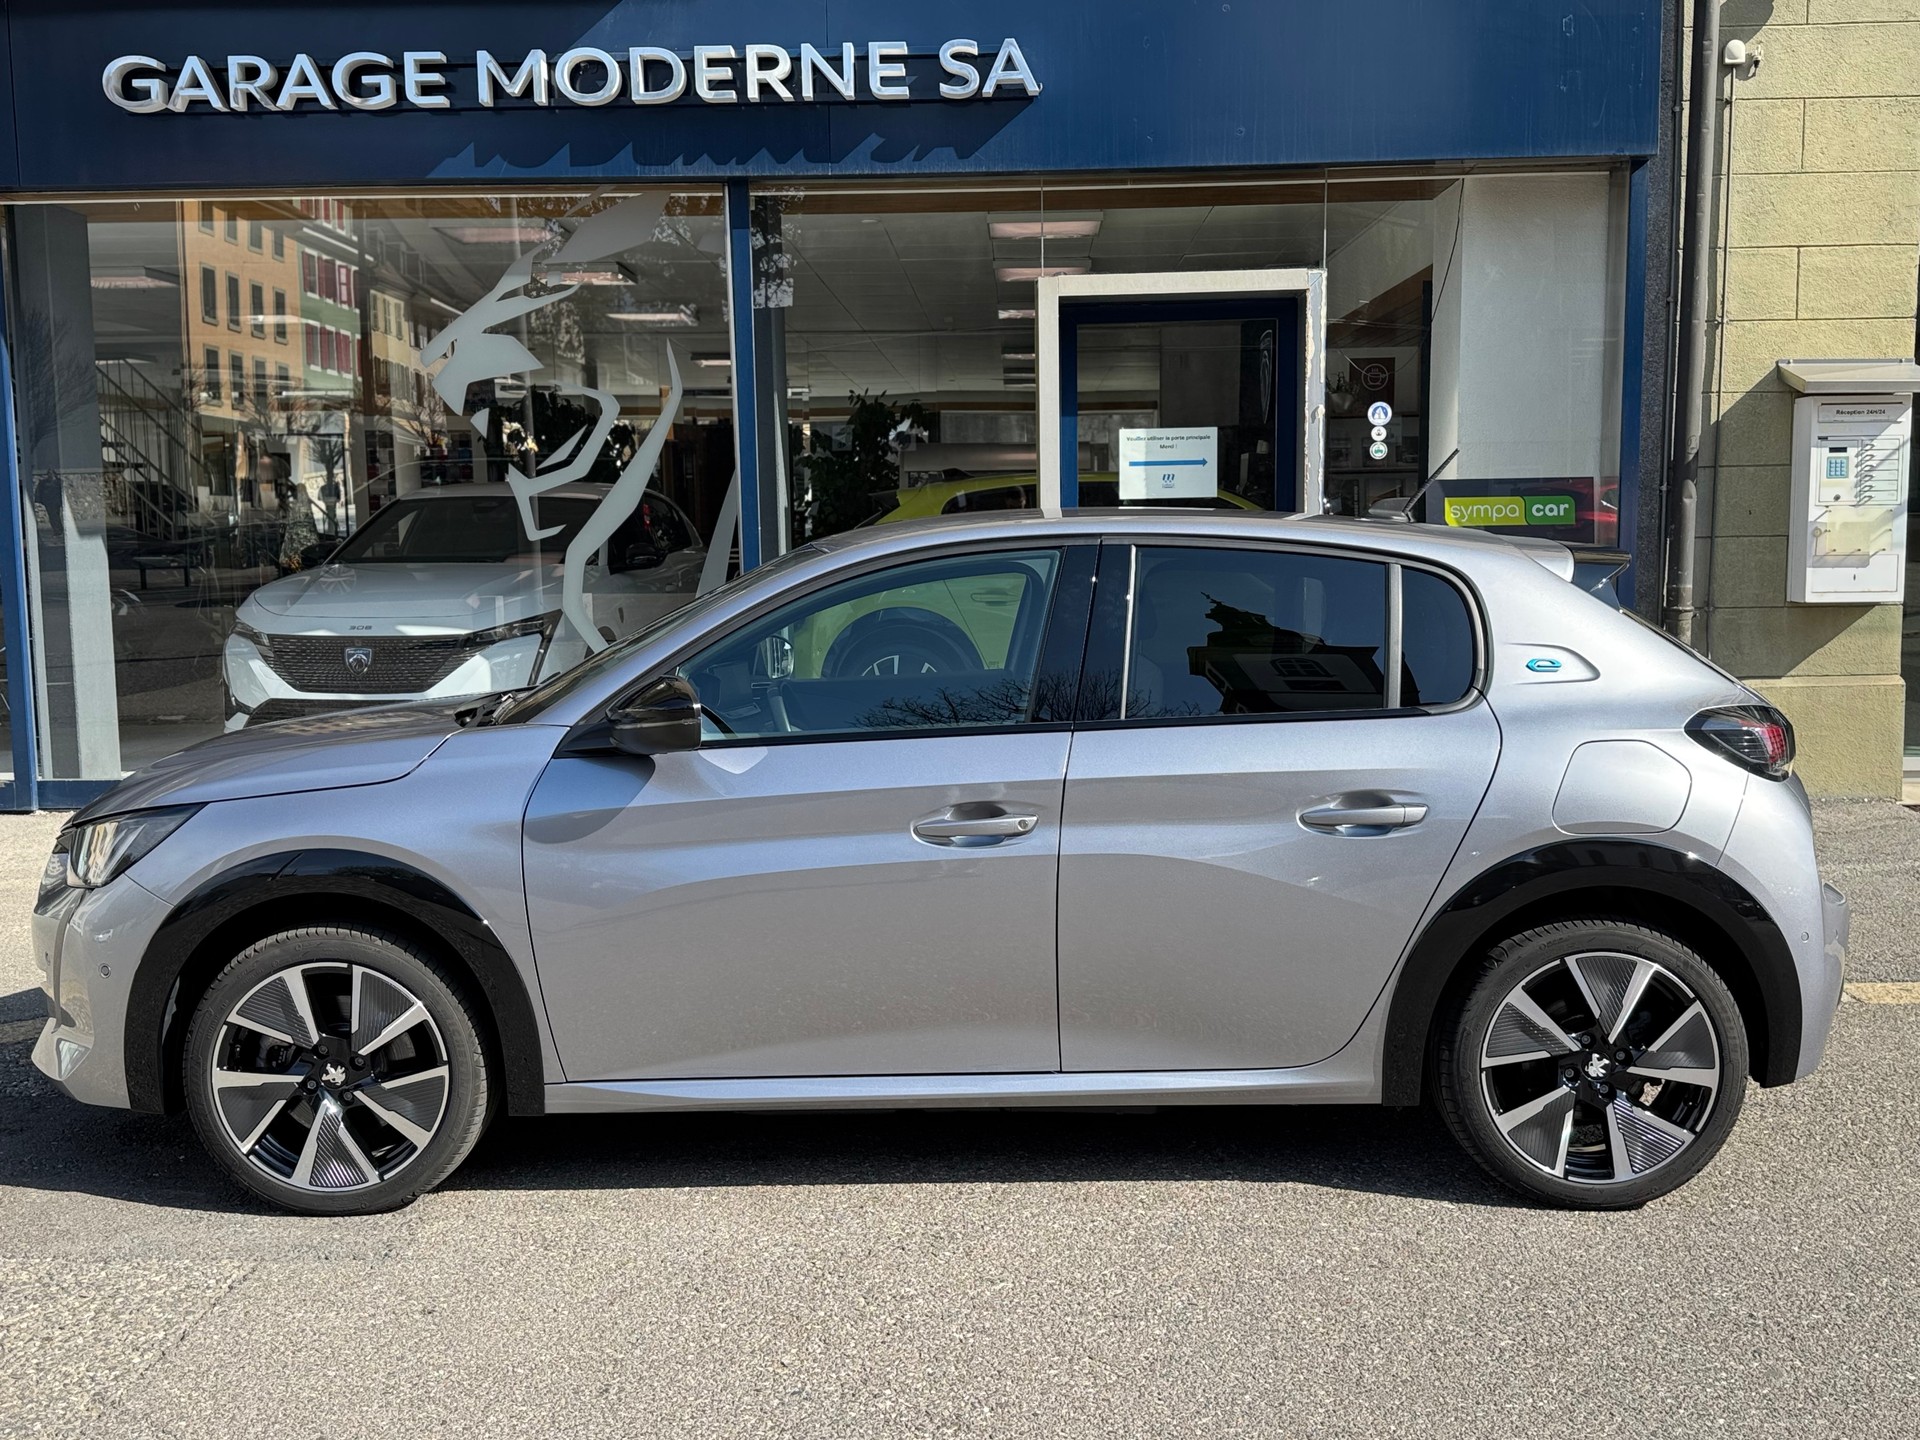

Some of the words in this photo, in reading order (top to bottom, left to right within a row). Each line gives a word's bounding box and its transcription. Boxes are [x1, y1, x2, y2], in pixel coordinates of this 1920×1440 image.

[102, 51, 450, 114] GARAGE
[476, 41, 910, 107] MODERNE
[939, 38, 1041, 99] SA
[1186, 434, 1211, 442] principale
[1450, 504, 1520, 522] sympa
[1531, 503, 1570, 517] car
